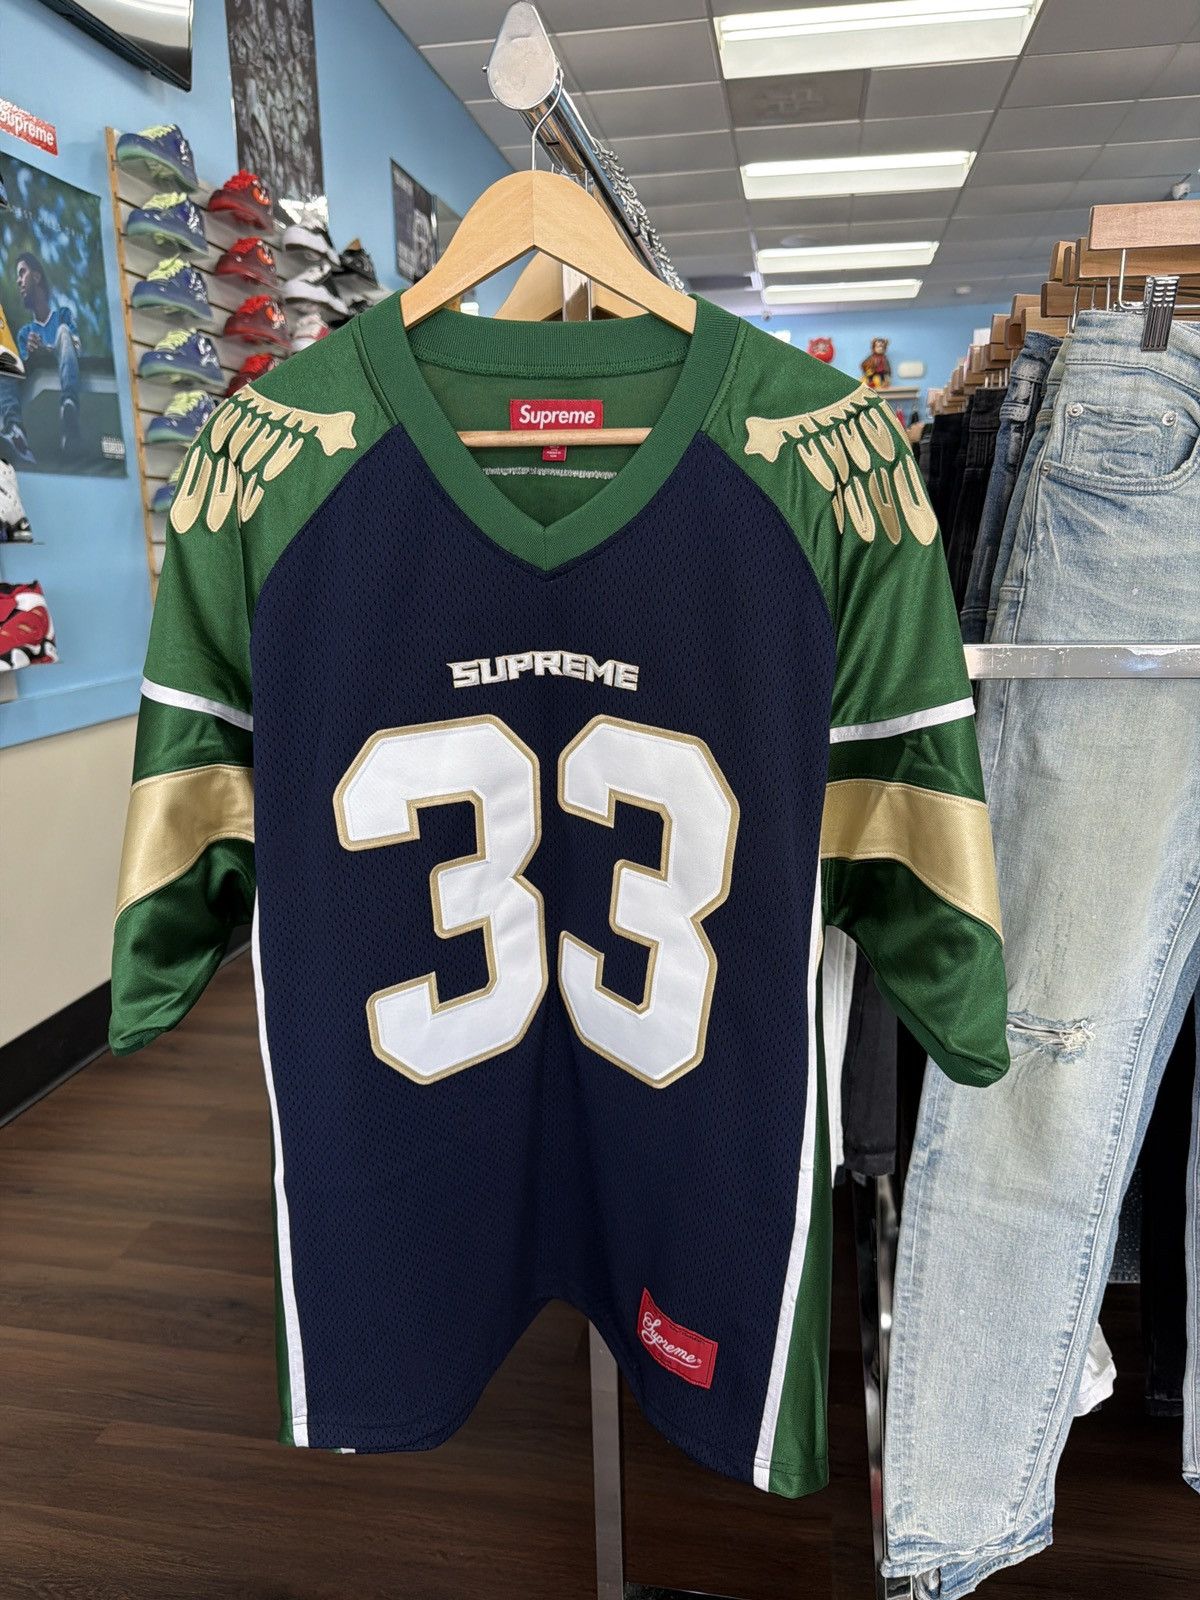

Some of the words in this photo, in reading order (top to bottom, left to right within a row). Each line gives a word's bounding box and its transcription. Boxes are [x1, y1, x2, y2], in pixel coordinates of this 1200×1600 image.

[519, 404, 596, 429] Supreme
[446, 650, 639, 691] SUPREME
[332, 713, 741, 1089] 33
